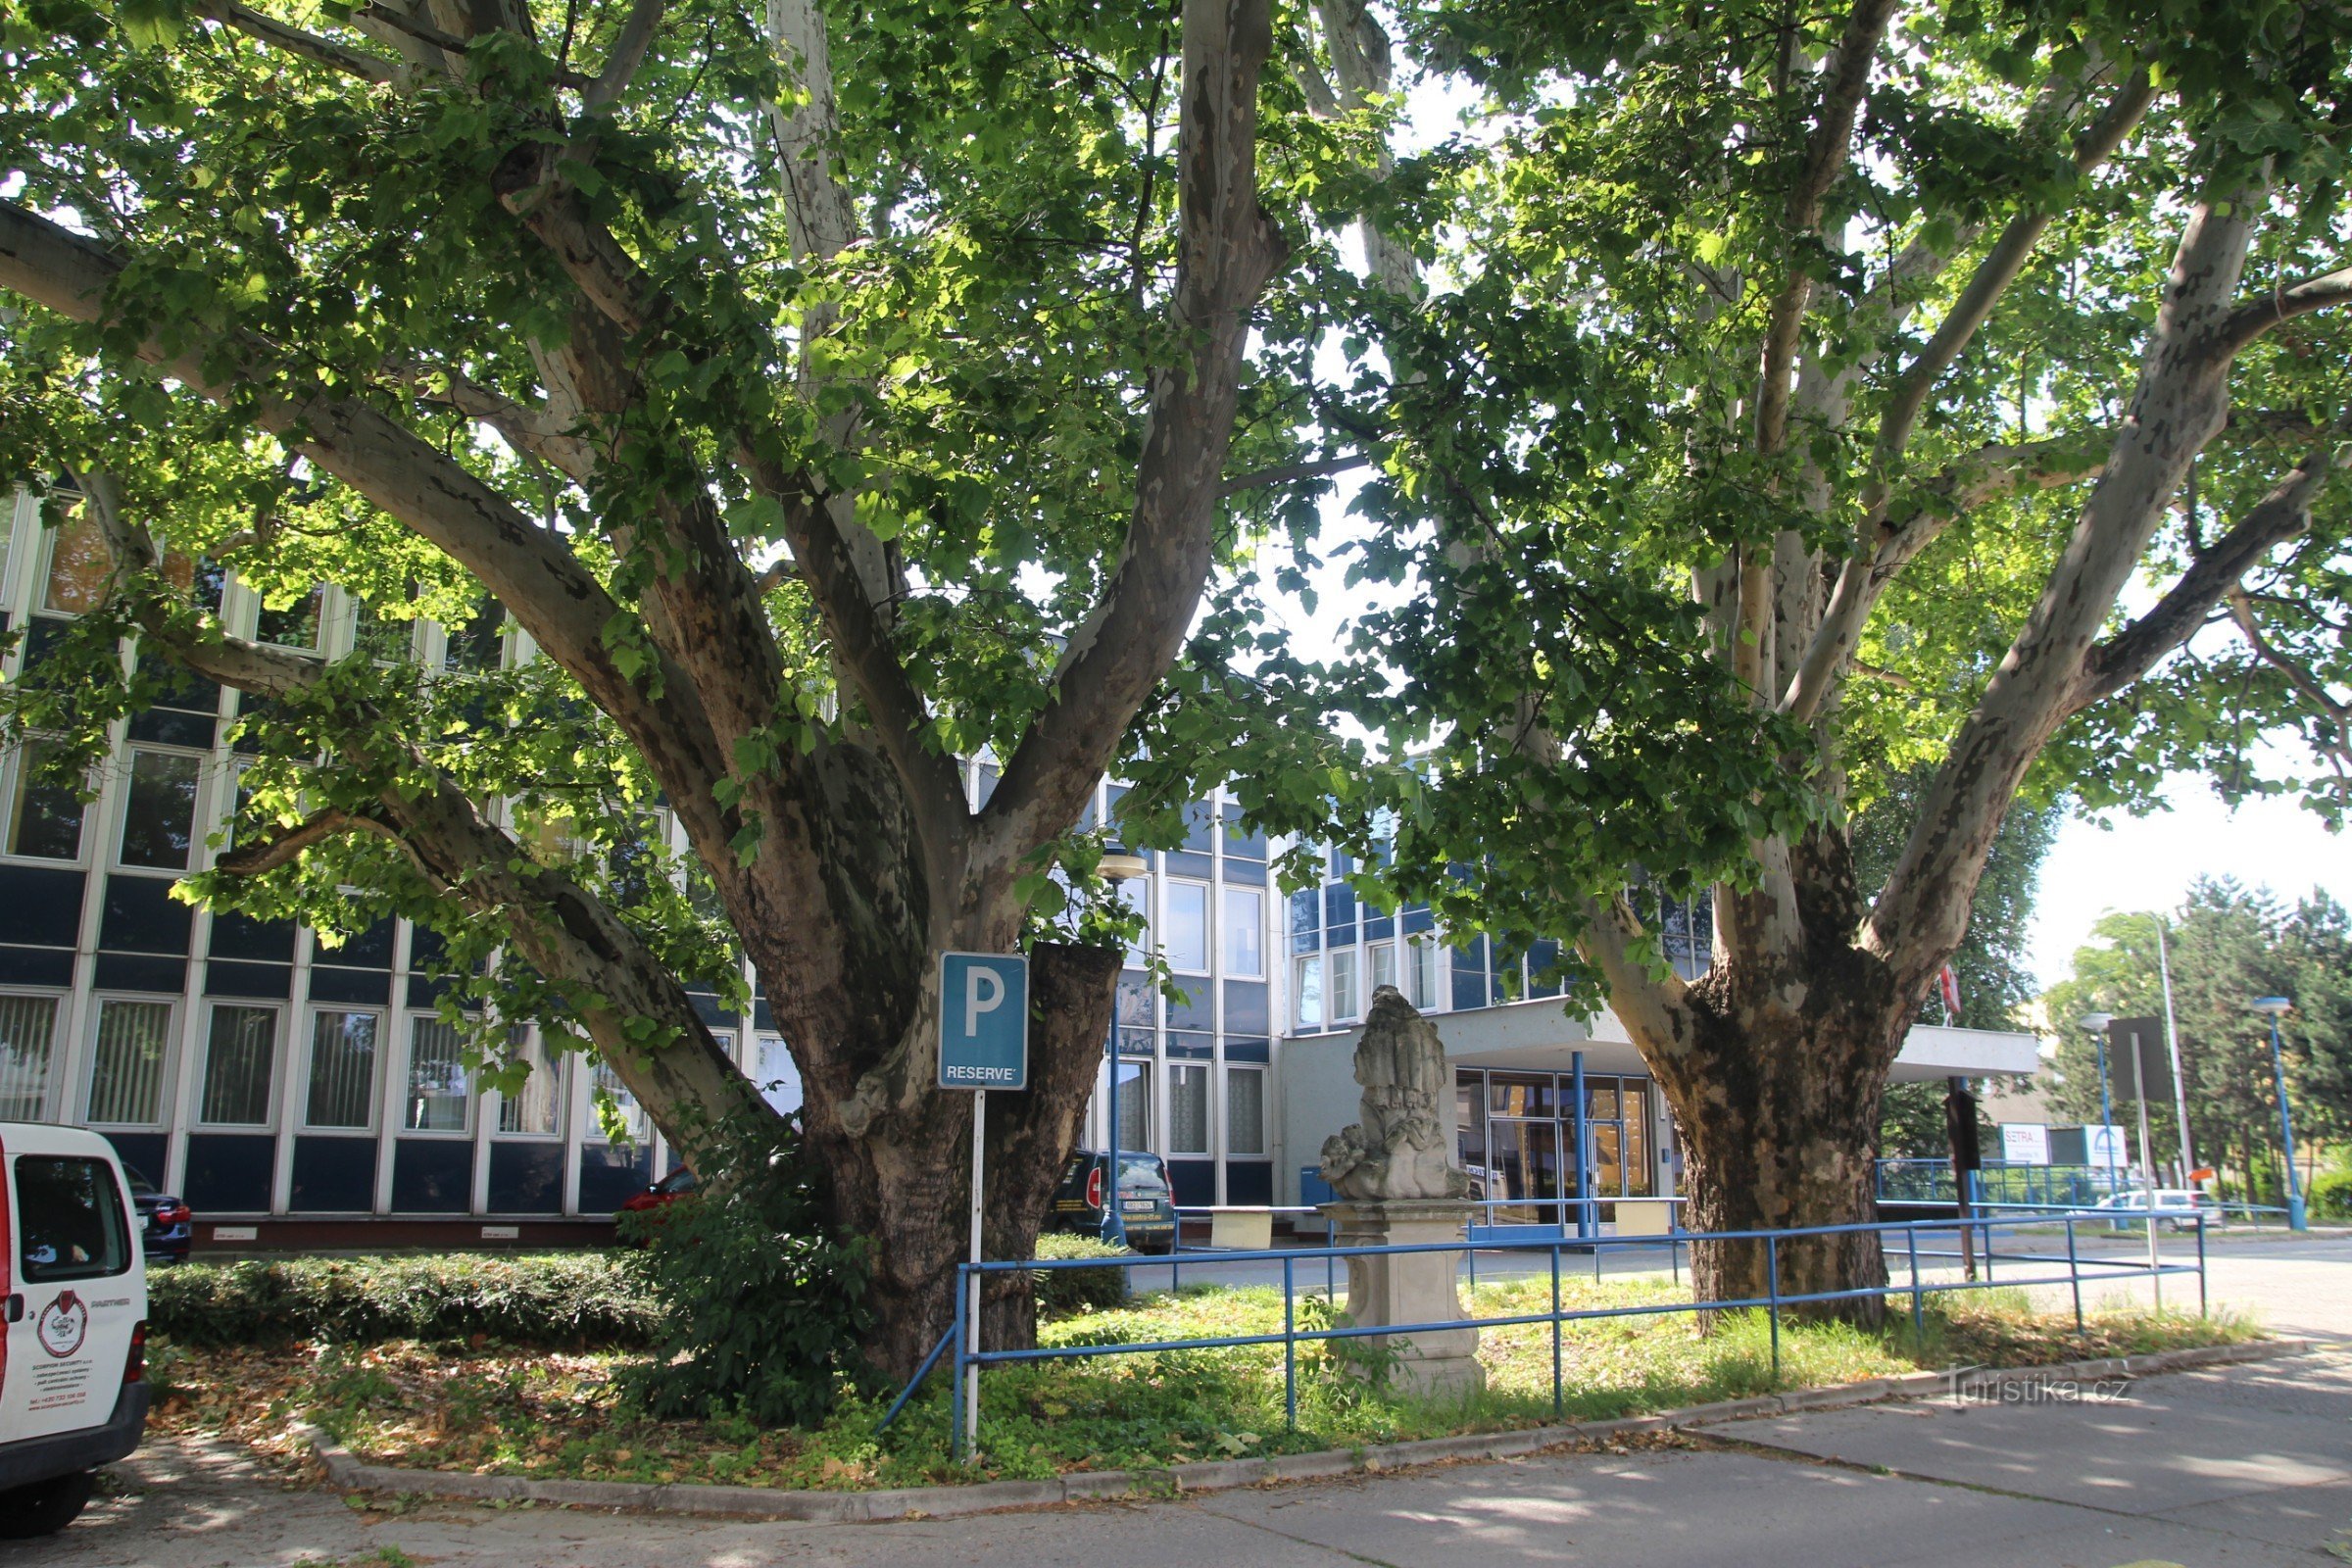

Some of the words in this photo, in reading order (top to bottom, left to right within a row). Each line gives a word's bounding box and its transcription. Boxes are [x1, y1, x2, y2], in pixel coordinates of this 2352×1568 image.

[965, 965, 1005, 1037] P
[2005, 1130, 2034, 1144] SETRA
[90, 1298, 131, 1308] PARTNER
[31, 1362, 59, 1371] SCORPION
